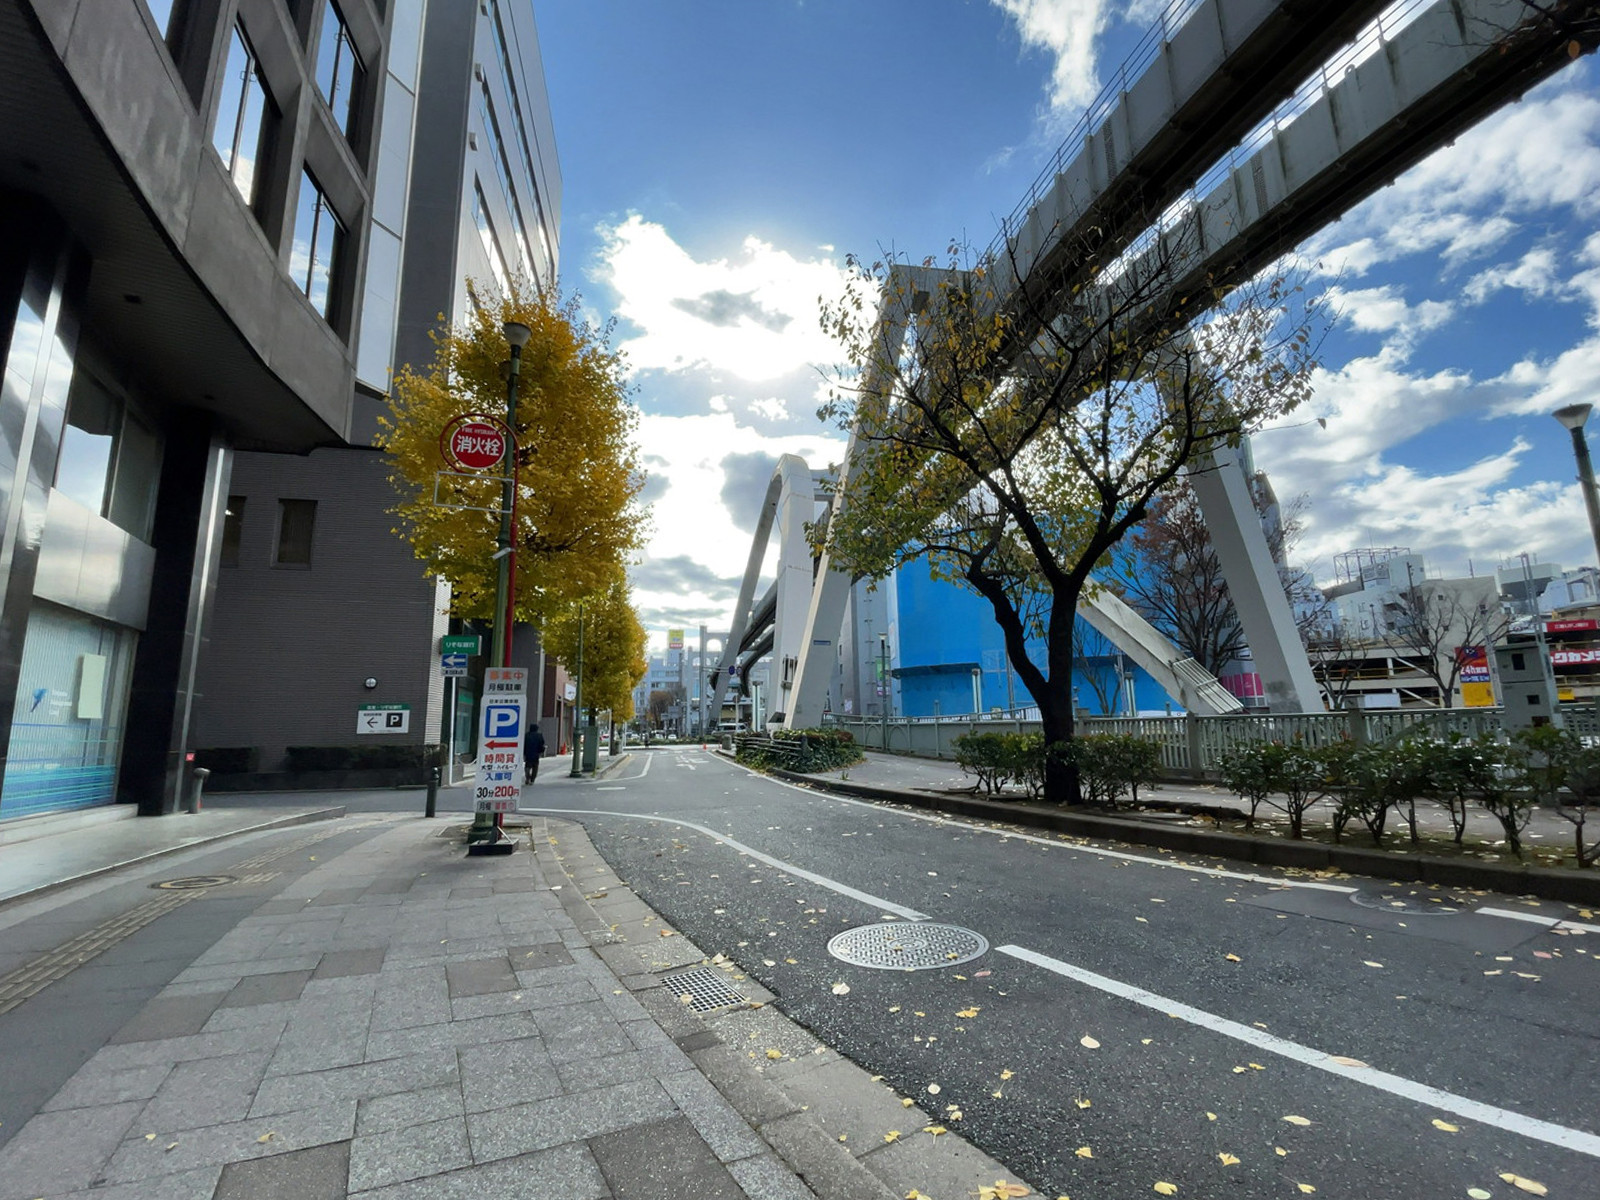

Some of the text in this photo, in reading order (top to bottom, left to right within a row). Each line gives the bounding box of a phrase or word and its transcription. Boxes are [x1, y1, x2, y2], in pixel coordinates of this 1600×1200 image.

[456, 435, 500, 456] 消火栓
[390, 715, 400, 726] P
[489, 708, 518, 737] P
[484, 753, 515, 764] 時間貸
